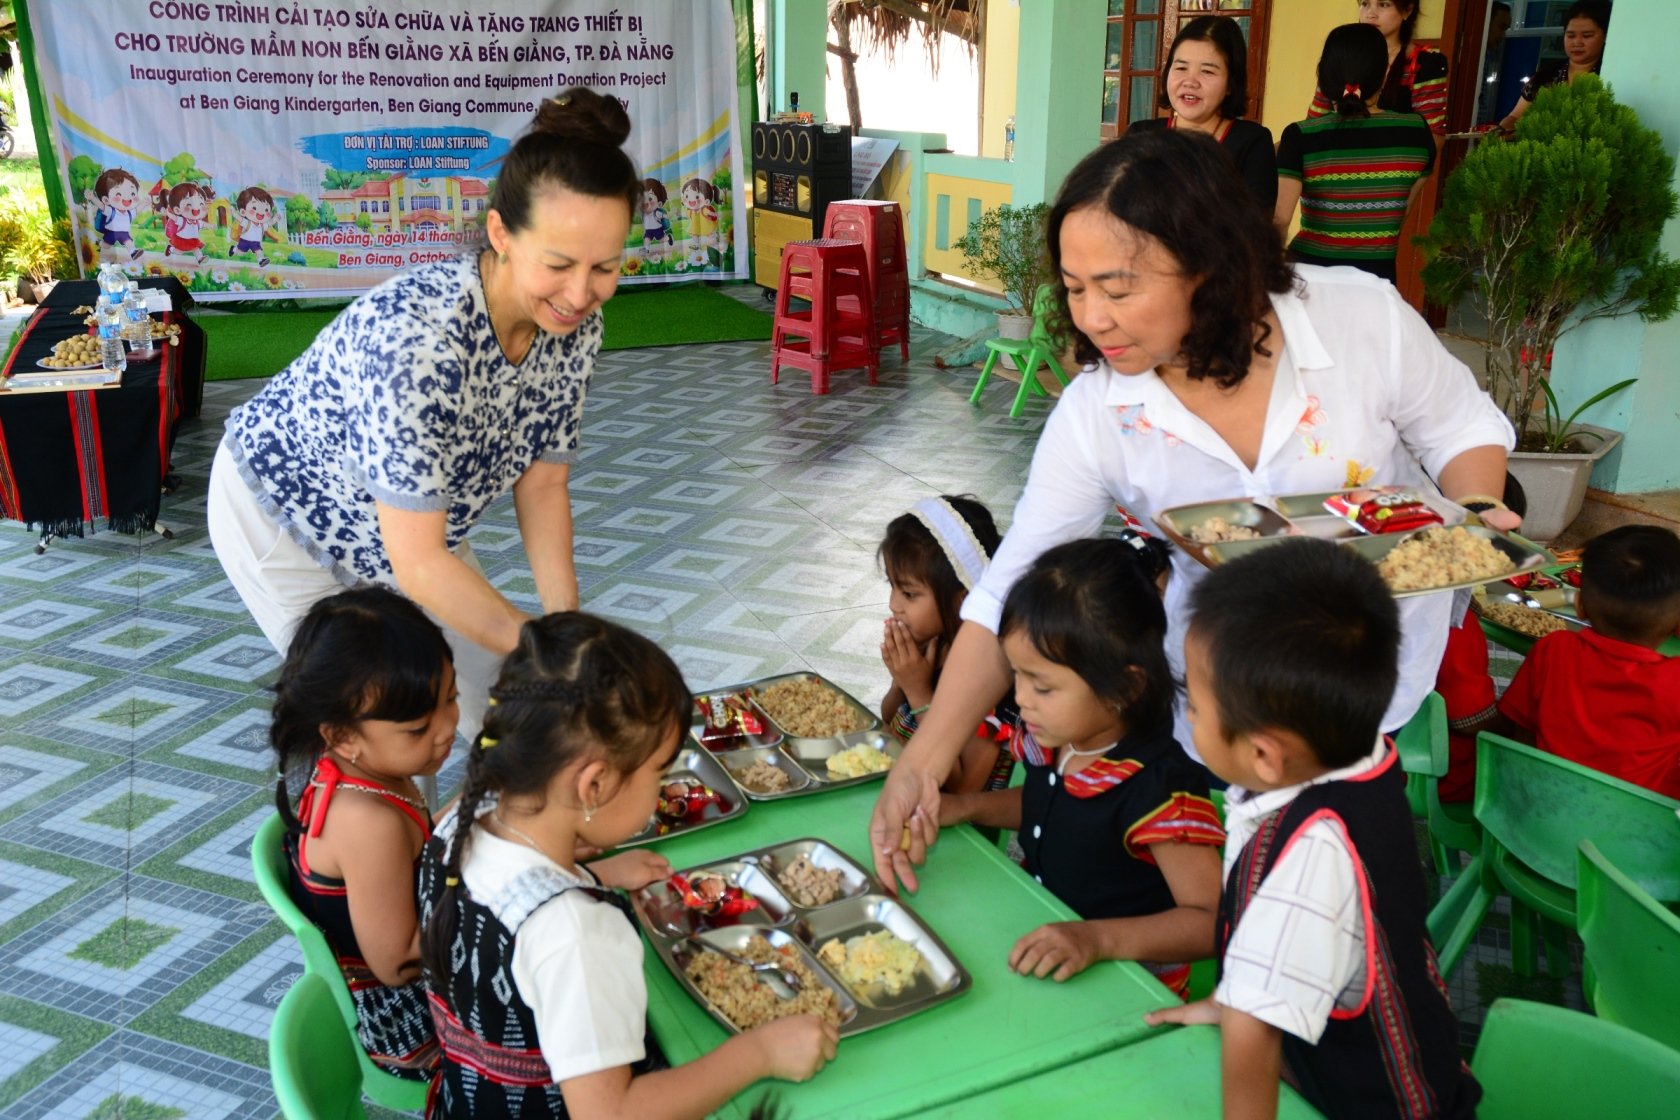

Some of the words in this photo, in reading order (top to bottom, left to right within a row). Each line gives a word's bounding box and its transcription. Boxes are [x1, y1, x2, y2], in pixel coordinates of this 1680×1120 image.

[149, 0, 210, 21] CÔNG
[217, 1, 269, 24] TRÌNH
[276, 2, 308, 25] CẢI
[314, 10, 350, 34] TẠO
[356, 6, 389, 29] SỬA
[395, 11, 444, 31] CHỮA
[449, 11, 473, 32] VÀ
[479, 13, 524, 37] TẶNG
[530, 16, 579, 32] TRANG
[586, 9, 622, 32] THIẾT
[628, 16, 642, 36] BỊ
[115, 32, 160, 51] CHO
[166, 31, 244, 55] TRƯỜNG
[251, 30, 295, 57] MẦM
[302, 41, 341, 58] NON
[348, 35, 379, 59] BẾN
[386, 36, 443, 61] GIẰNG
[449, 41, 473, 61] XÃ
[479, 39, 508, 62] BẾN
[514, 38, 570, 63] GIẰNG,
[575, 44, 594, 61] TP.
[600, 41, 621, 60] ĐÀ
[627, 37, 673, 60] NẴNG
[130, 65, 232, 84] Inauguration
[237, 68, 313, 86] Ceremony
[319, 71, 338, 84] for
[342, 71, 365, 85] the
[370, 72, 449, 88] Renovation
[454, 73, 479, 88] and
[485, 74, 553, 91] Equipment
[558, 72, 616, 87] Donation
[620, 72, 666, 87] Project
[180, 95, 195, 109] at
[201, 95, 228, 110] Ben
[234, 97, 279, 114] Giang
[285, 98, 384, 114] Kindergarten,
[389, 100, 415, 112] Ben
[419, 99, 461, 116] Giang
[466, 100, 538, 114] Commune,
[344, 136, 365, 150] ĐƠN
[367, 136, 377, 152] VỊ
[379, 134, 394, 149] TÀI
[395, 134, 413, 152] TRỢ
[421, 137, 445, 149] LOAN
[447, 136, 488, 149] STIFTUNG
[366, 157, 406, 171] Sponsor:
[409, 157, 433, 169] LOAN
[435, 157, 469, 170] Stiftung
[306, 229, 329, 245] Bến
[334, 229, 373, 247] Giằng,
[377, 230, 408, 247] ngày
[412, 231, 427, 243] 14
[429, 230, 463, 244] tháng
[339, 253, 362, 266] Ben
[367, 253, 405, 267] Giang,
